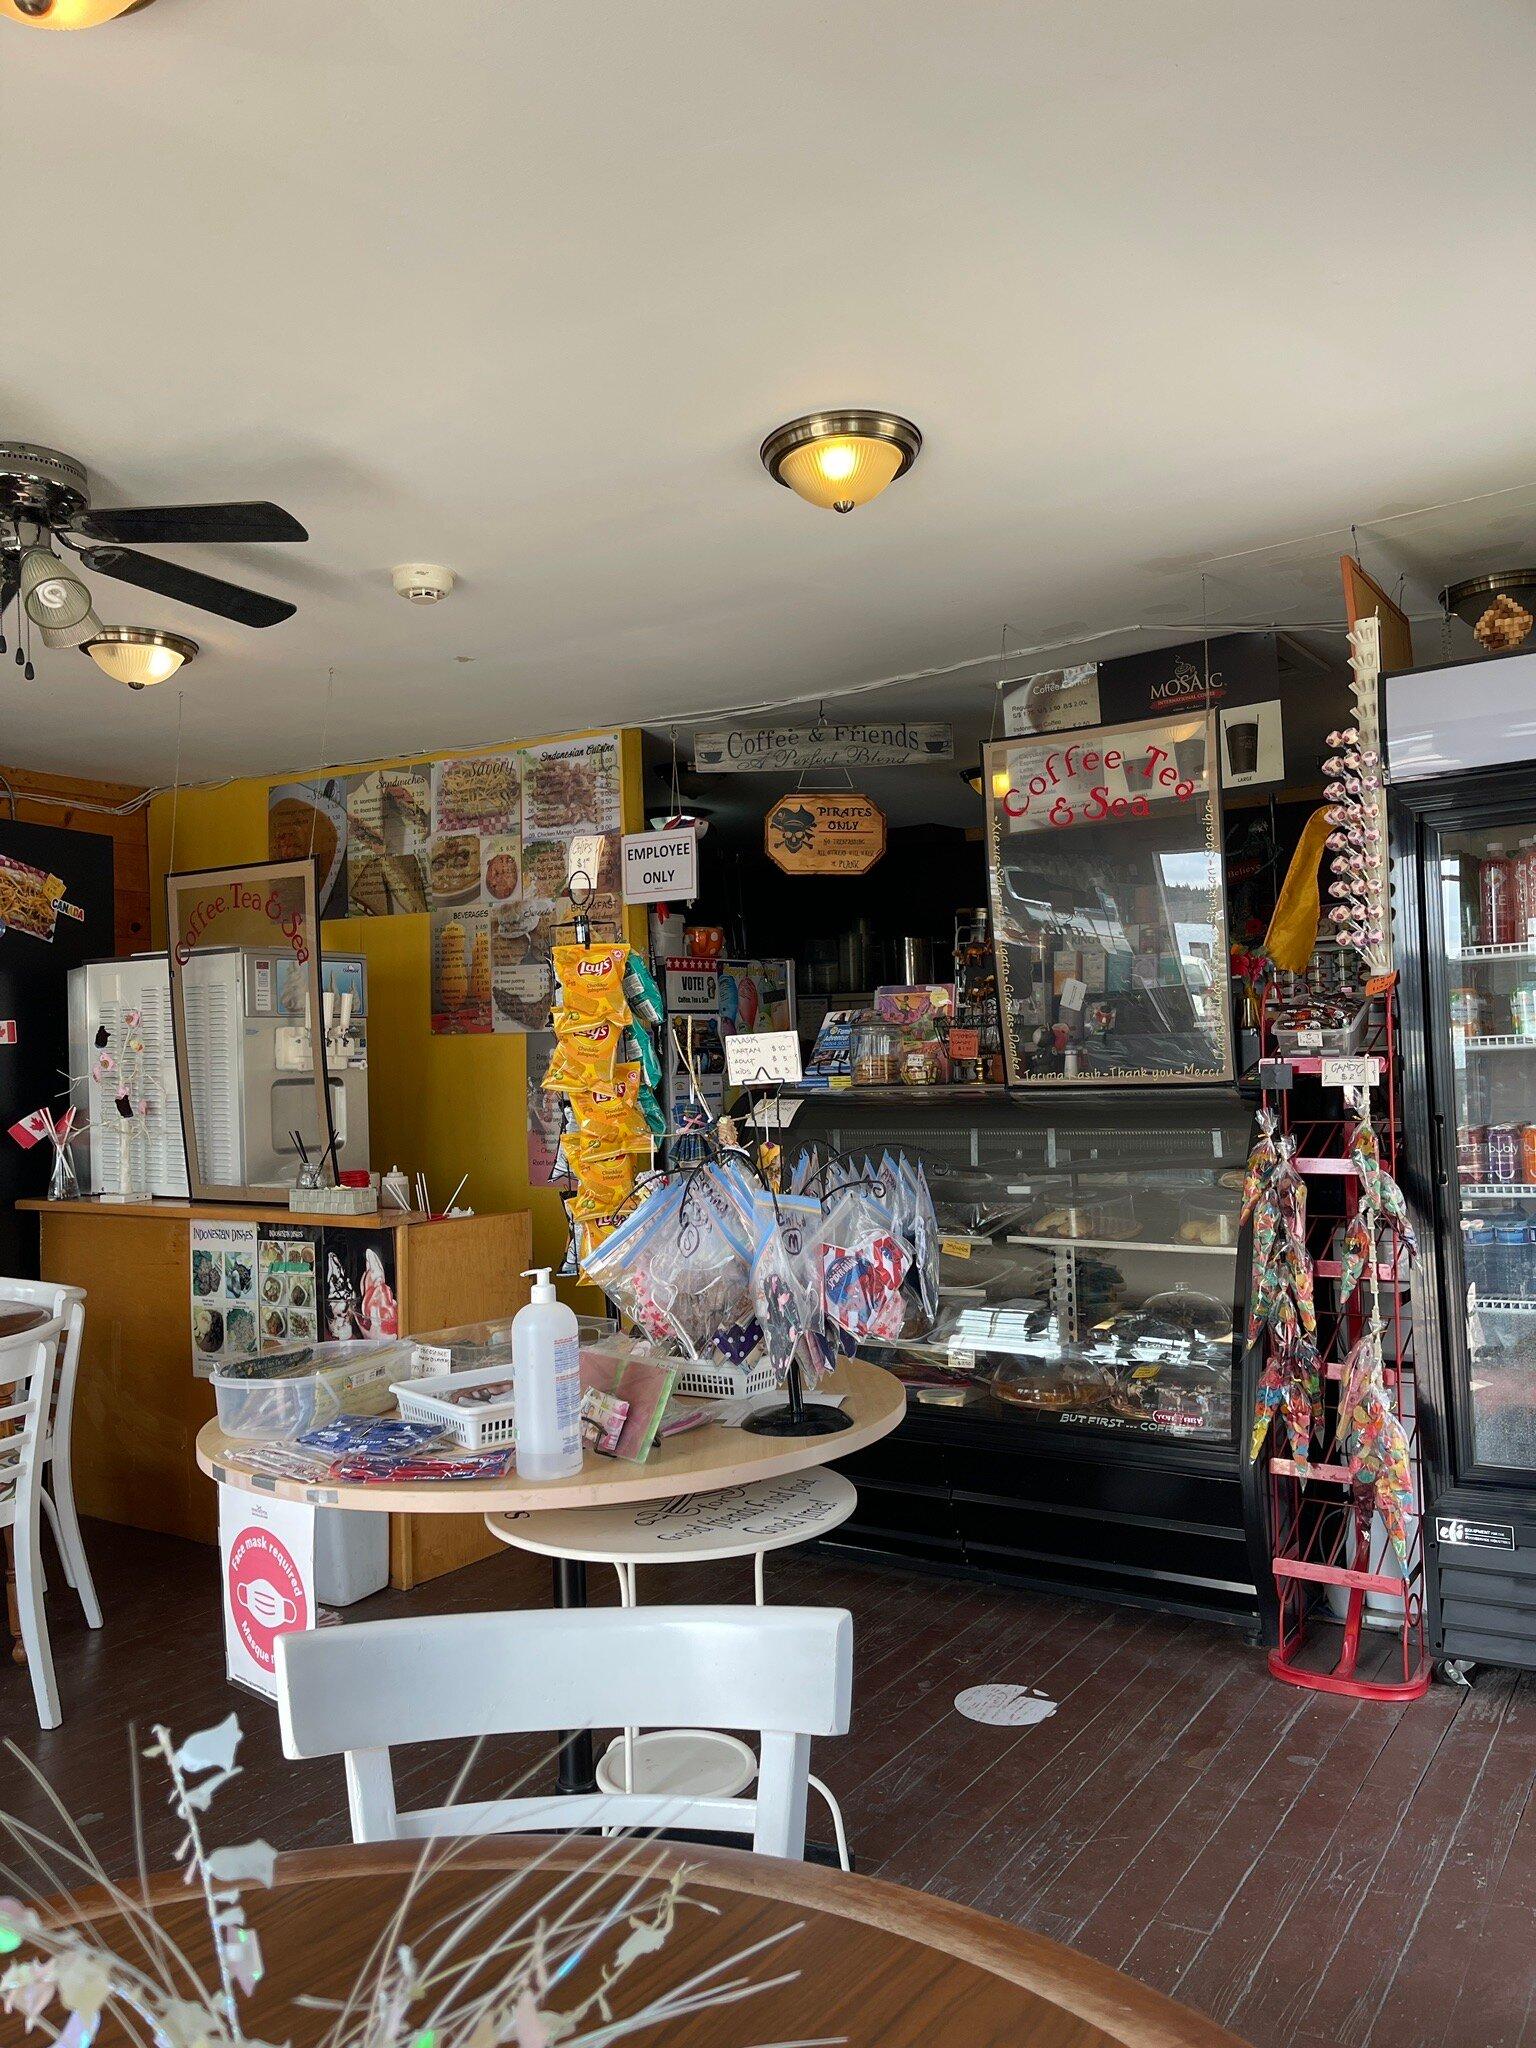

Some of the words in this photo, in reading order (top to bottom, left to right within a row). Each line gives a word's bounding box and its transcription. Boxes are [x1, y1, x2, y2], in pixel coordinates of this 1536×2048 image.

[1033, 683, 1060, 694] Coffee
[1150, 671, 1223, 700] MOSAIC
[727, 729, 799, 759] Coffee
[808, 728, 824, 743] &
[834, 724, 919, 750] Friends
[769, 748, 836, 768] Perfect
[844, 746, 911, 765] Blend
[1141, 746, 1194, 802] Tea
[817, 806, 872, 818] PIRATES
[1049, 796, 1075, 828] &
[1084, 786, 1150, 821] Sea
[828, 820, 859, 830] ONLY
[628, 842, 690, 861] EMPLOYEE
[643, 870, 675, 884] ONLY
[51, 898, 84, 920] CANADA
[453, 910, 489, 920] BEVERAGES
[230, 882, 261, 912] Tea
[265, 890, 282, 920] &
[281, 912, 310, 966] Sea
[682, 976, 704, 990] VOTE!
[1024, 1070, 1064, 1082] Terima
[1109, 1066, 1149, 1080] Thank
[1152, 1069, 1174, 1082] you
[193, 1227, 230, 1241] INDONESIAN
[231, 1228, 254, 1242] DISHES
[1060, 1413, 1086, 1423] BUT
[1088, 1416, 1125, 1428] FIRST
[231, 1546, 246, 1572] Face
[246, 1536, 268, 1551] mask
[268, 1543, 303, 1598] required
[241, 1620, 270, 1663] Masque
